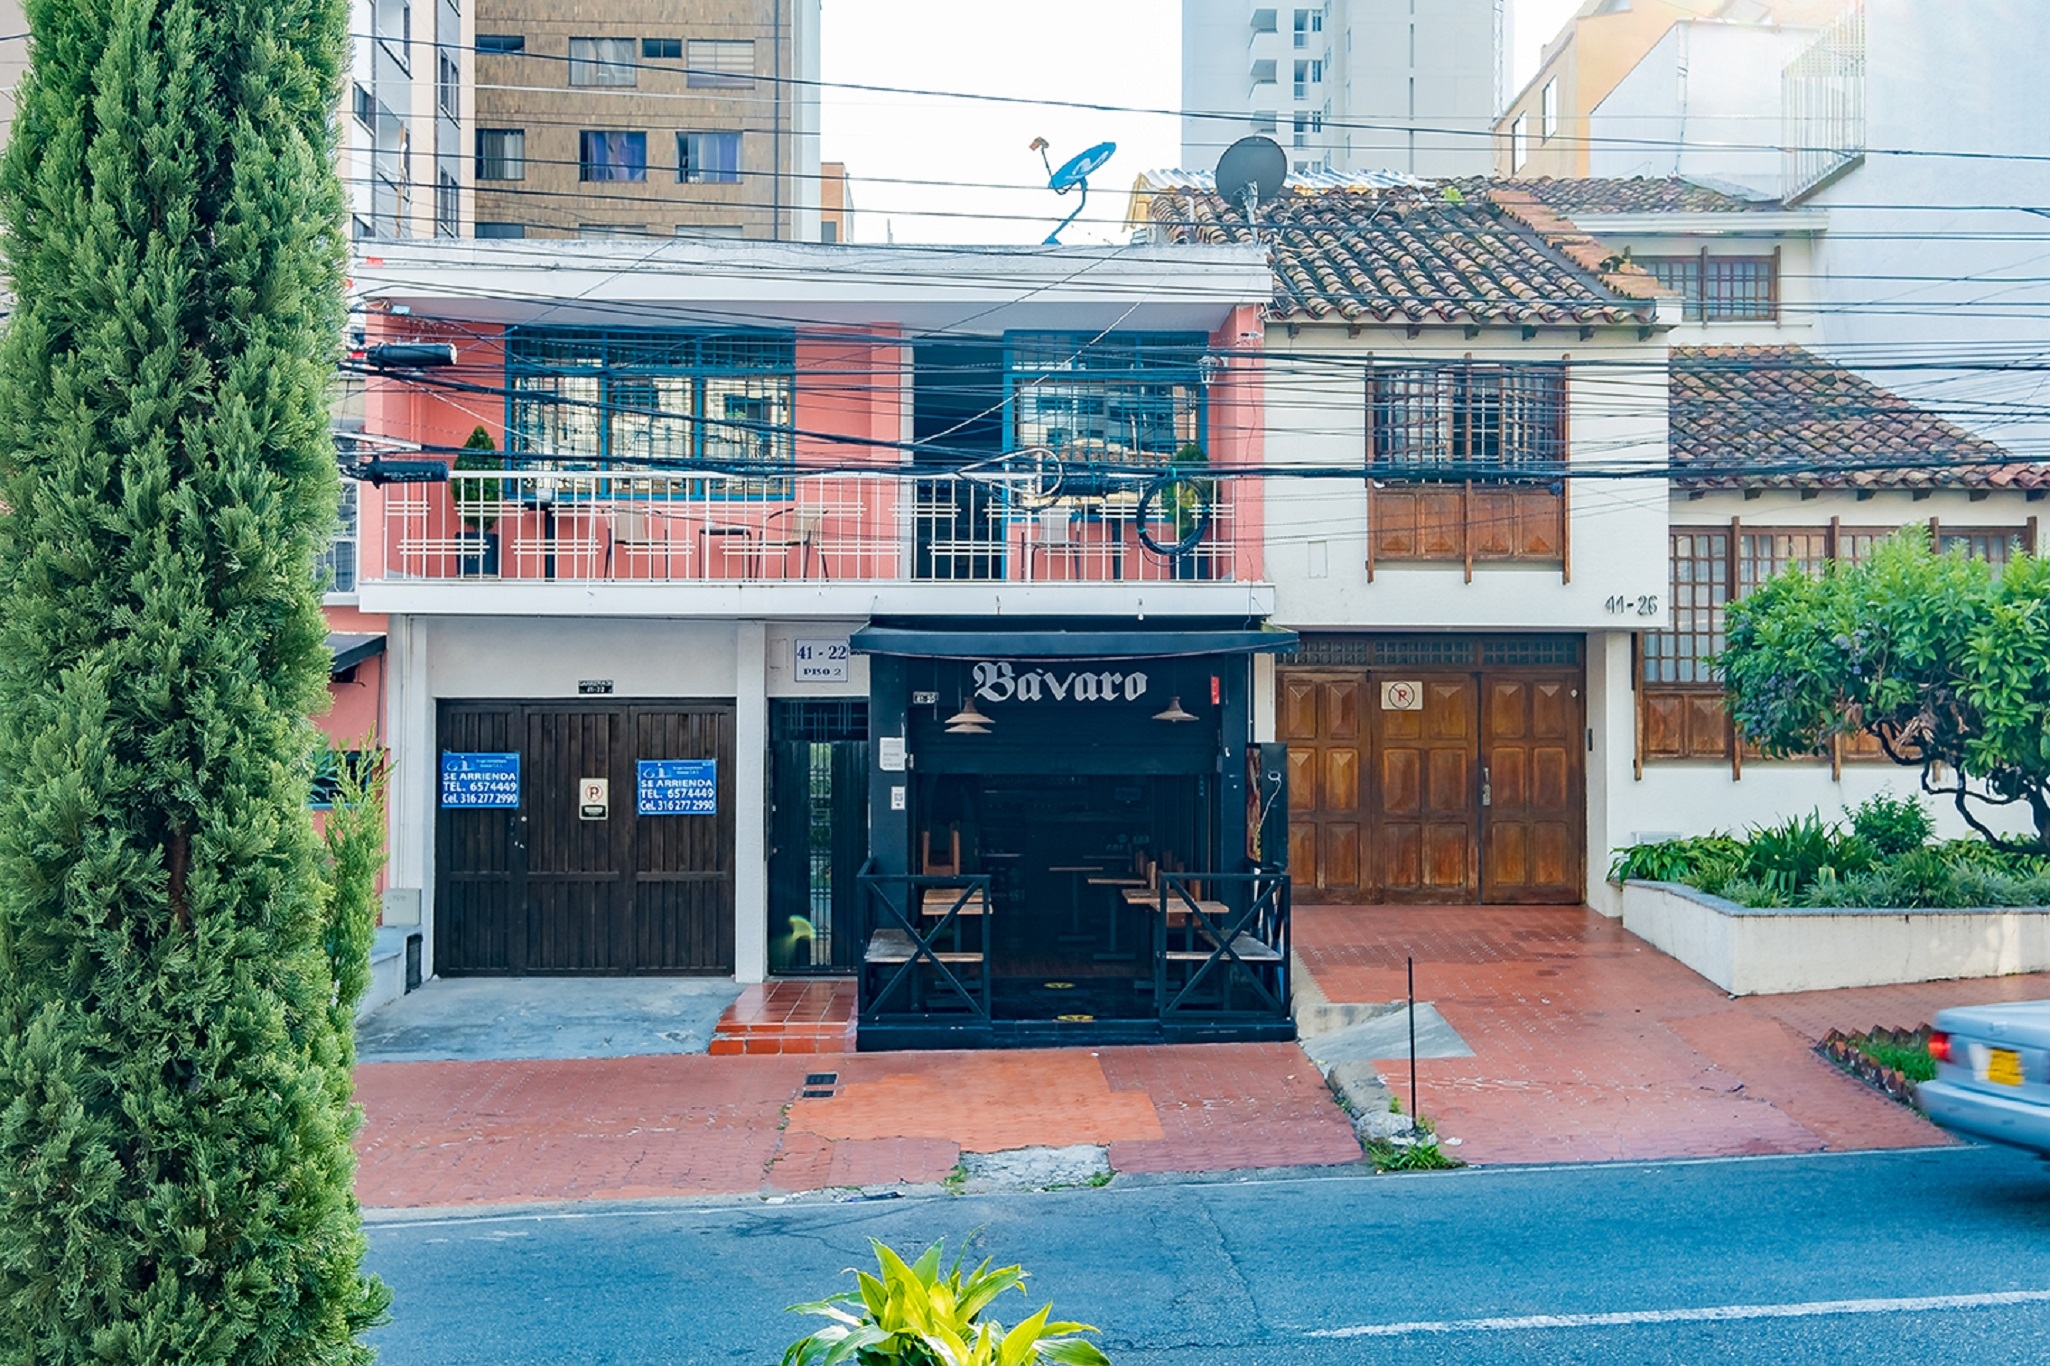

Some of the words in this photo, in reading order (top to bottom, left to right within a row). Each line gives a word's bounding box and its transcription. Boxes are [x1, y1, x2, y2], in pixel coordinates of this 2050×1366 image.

[1604, 594, 1658, 616] 41-26
[803, 668, 831, 676] PISO
[833, 668, 842, 677] 2
[443, 772, 457, 781] SE
[459, 772, 516, 781] ARRIENDA
[443, 781, 466, 792] TEL.
[469, 781, 517, 792] 6574449
[641, 780, 654, 788] SE
[656, 779, 713, 788] ARRIENDA
[641, 788, 663, 799] TEL.
[667, 787, 714, 799] 6574449
